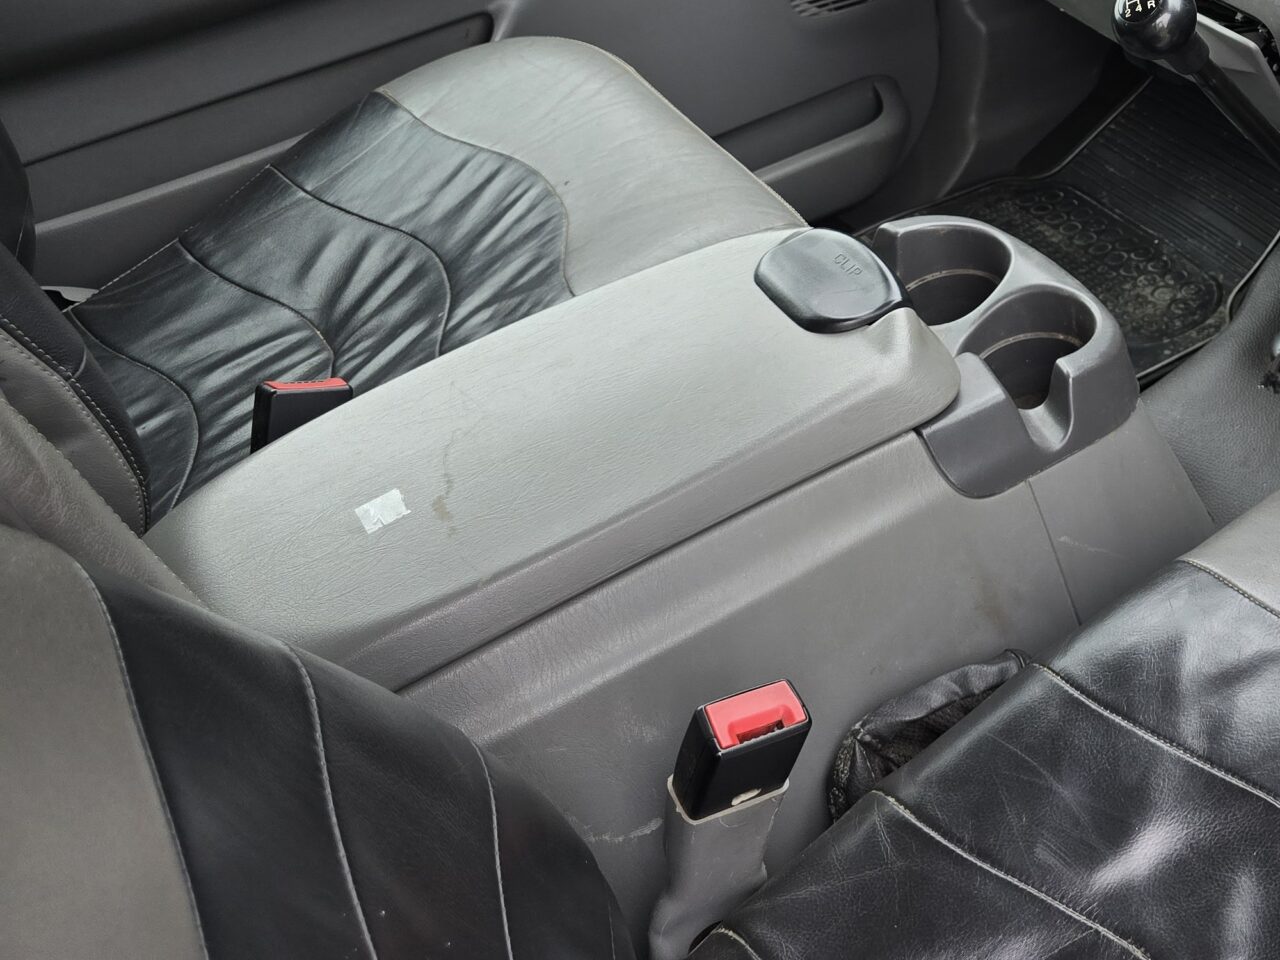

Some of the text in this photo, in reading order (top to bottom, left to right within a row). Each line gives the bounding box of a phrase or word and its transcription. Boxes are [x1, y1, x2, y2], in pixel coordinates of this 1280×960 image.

[1135, 4, 1142, 12] 4
[1147, 0, 1156, 9] R
[1124, 8, 1132, 18] 2
[833, 253, 863, 278] CLIP
